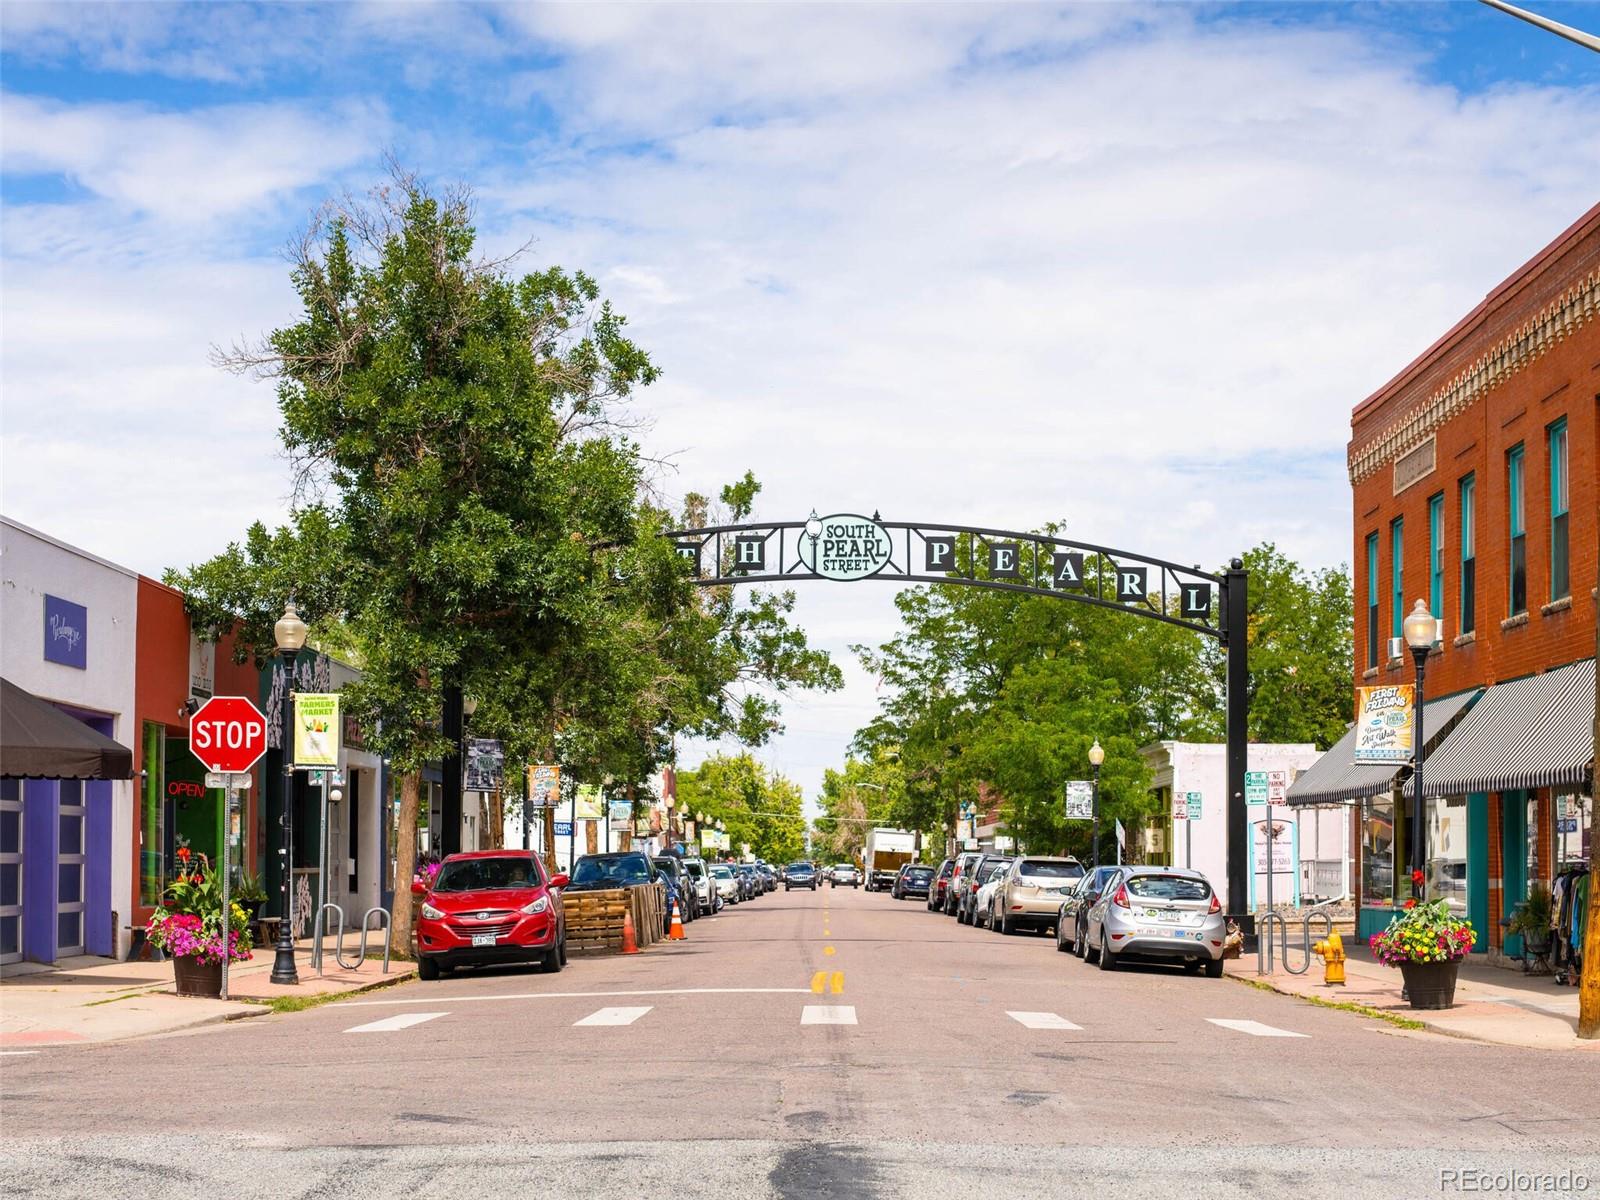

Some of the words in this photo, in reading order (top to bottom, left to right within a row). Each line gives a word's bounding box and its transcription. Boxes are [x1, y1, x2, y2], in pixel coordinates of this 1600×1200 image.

[826, 524, 875, 539] SOUTH
[822, 538, 888, 565] PEARL
[823, 559, 870, 573] STREET
[1369, 687, 1399, 701] FIRST
[299, 700, 336, 708] FARMERS
[1365, 697, 1407, 713] FRIDAYS
[301, 708, 333, 716] MARKET
[195, 720, 262, 749] STOP
[168, 781, 206, 799] OPEN
